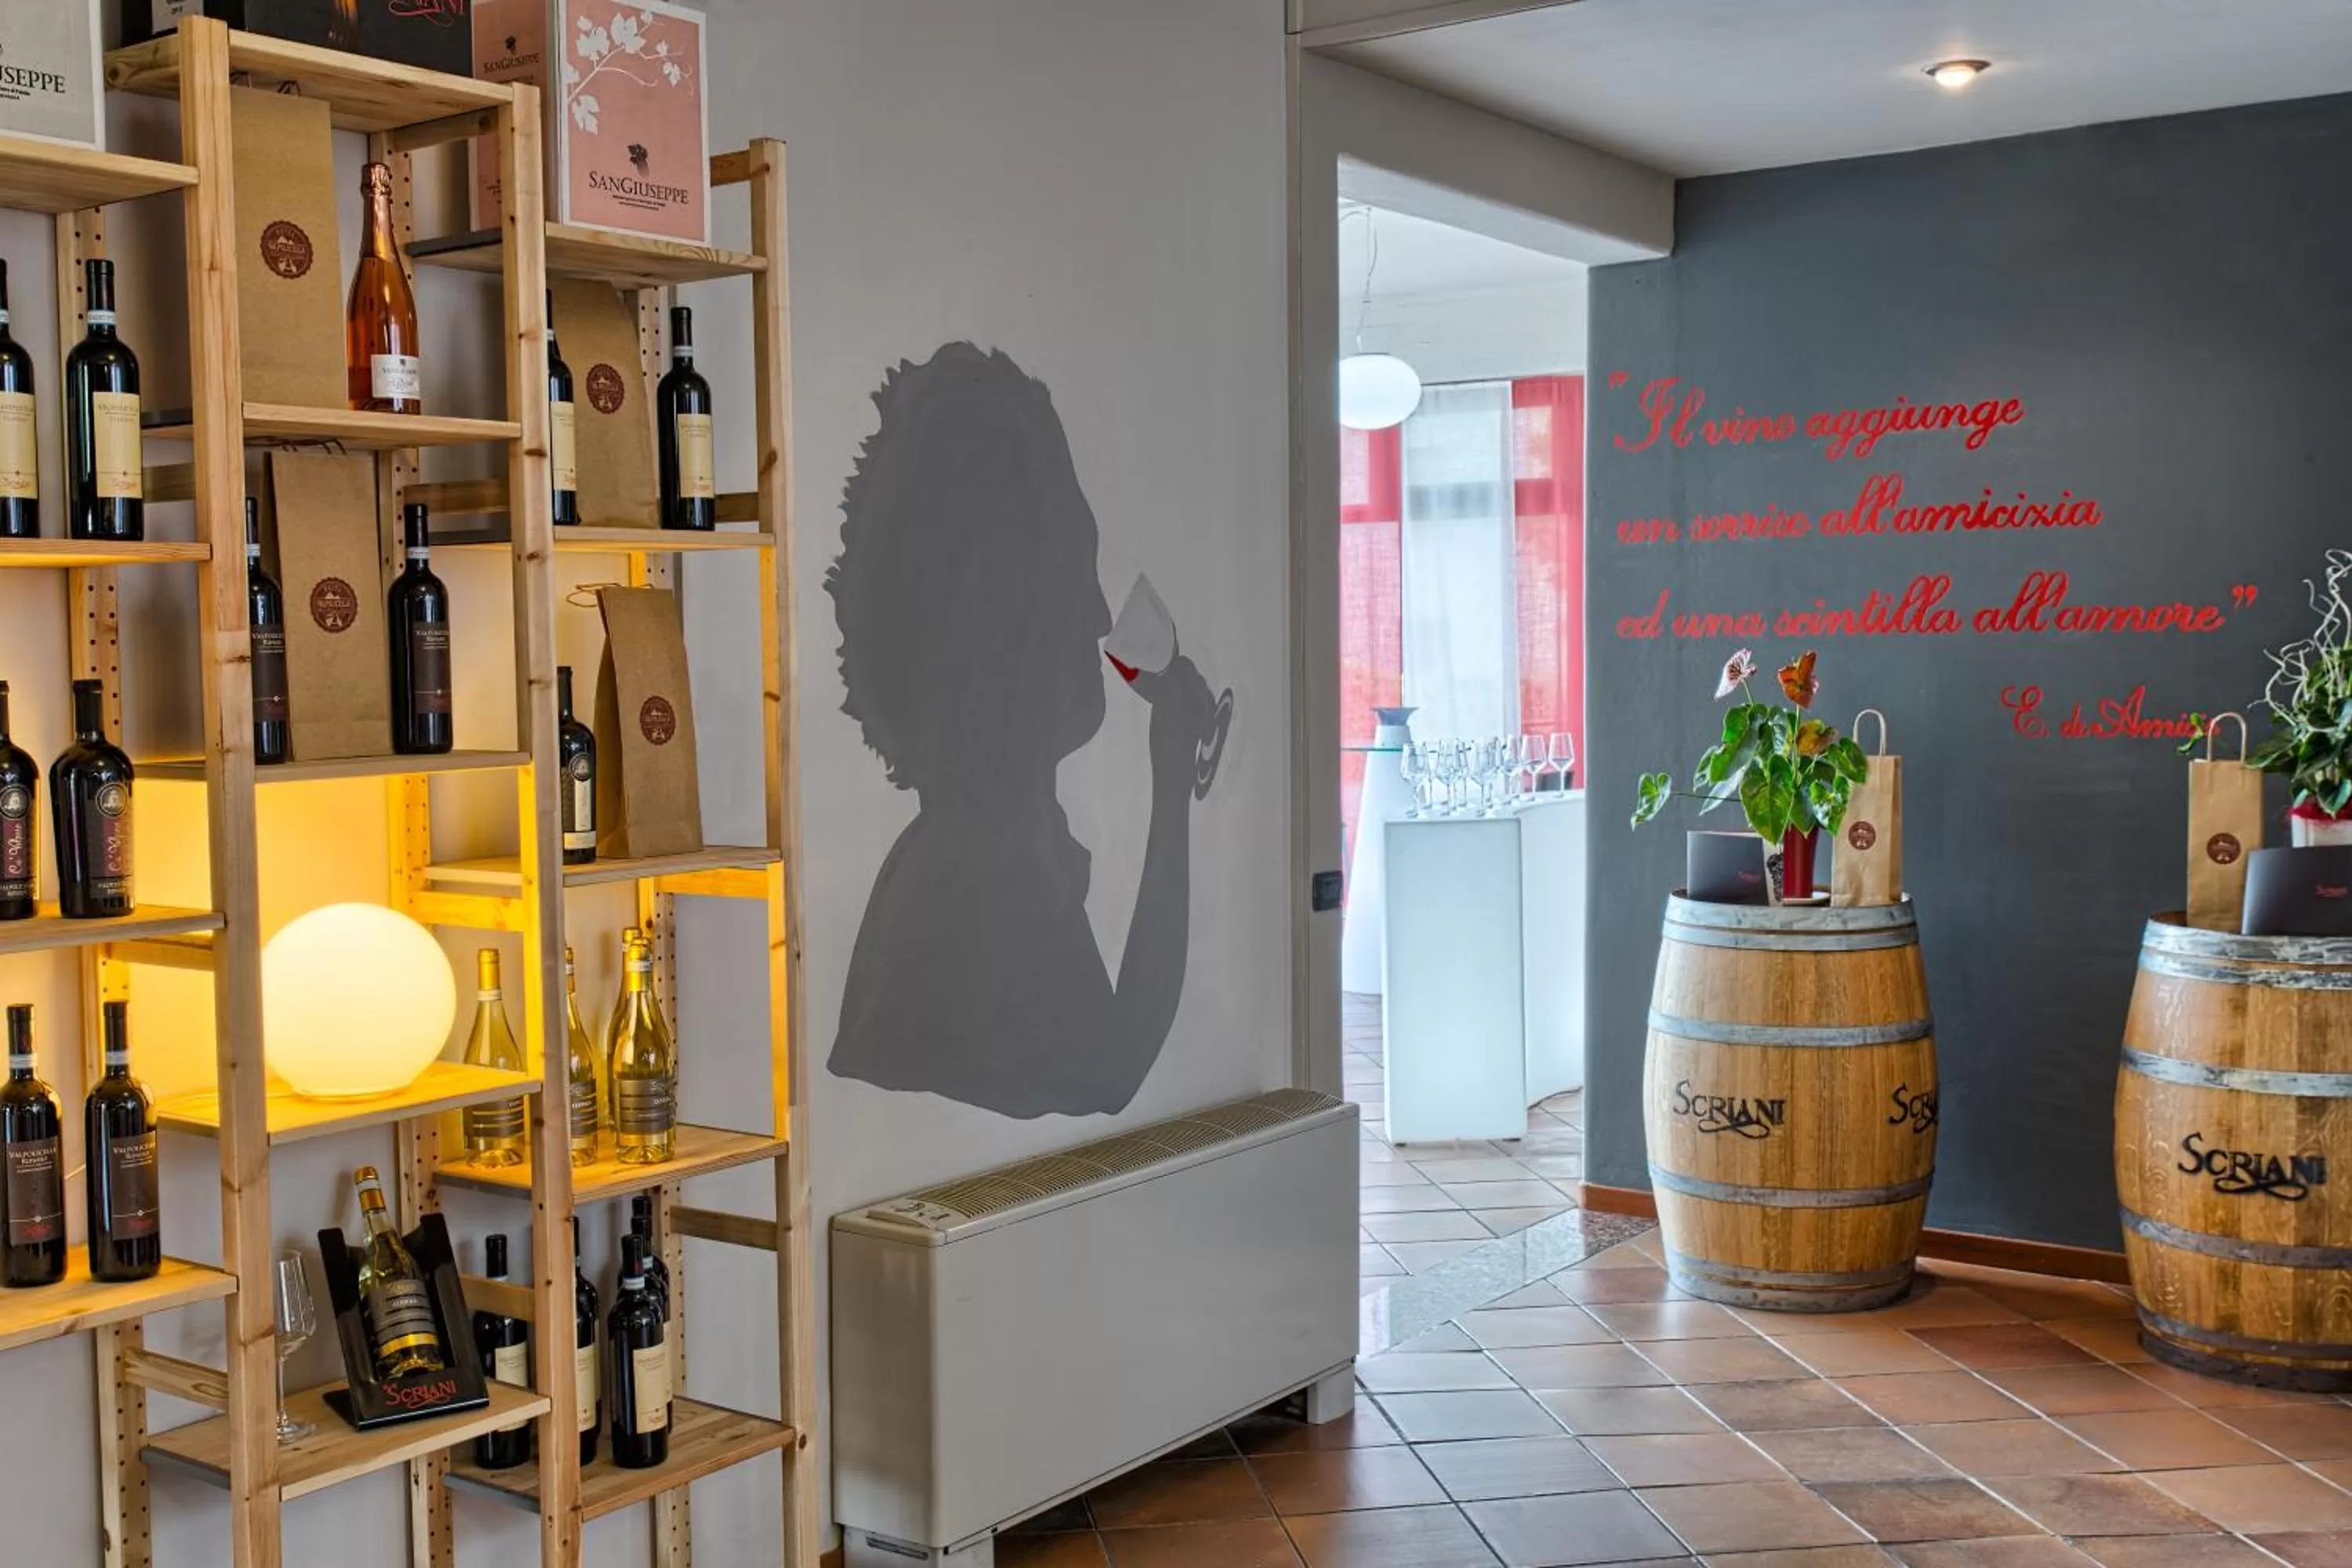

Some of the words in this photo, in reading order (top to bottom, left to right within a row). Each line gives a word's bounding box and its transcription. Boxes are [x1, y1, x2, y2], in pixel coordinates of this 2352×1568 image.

[1701, 405, 1795, 447] vino
[1806, 394, 2025, 461] aggiunge
[1616, 518, 1681, 544] un
[1690, 503, 1812, 542] sorriso
[1616, 586, 1671, 640] ed
[1672, 612, 1766, 639] una
[1773, 572, 1964, 638] scintilla
